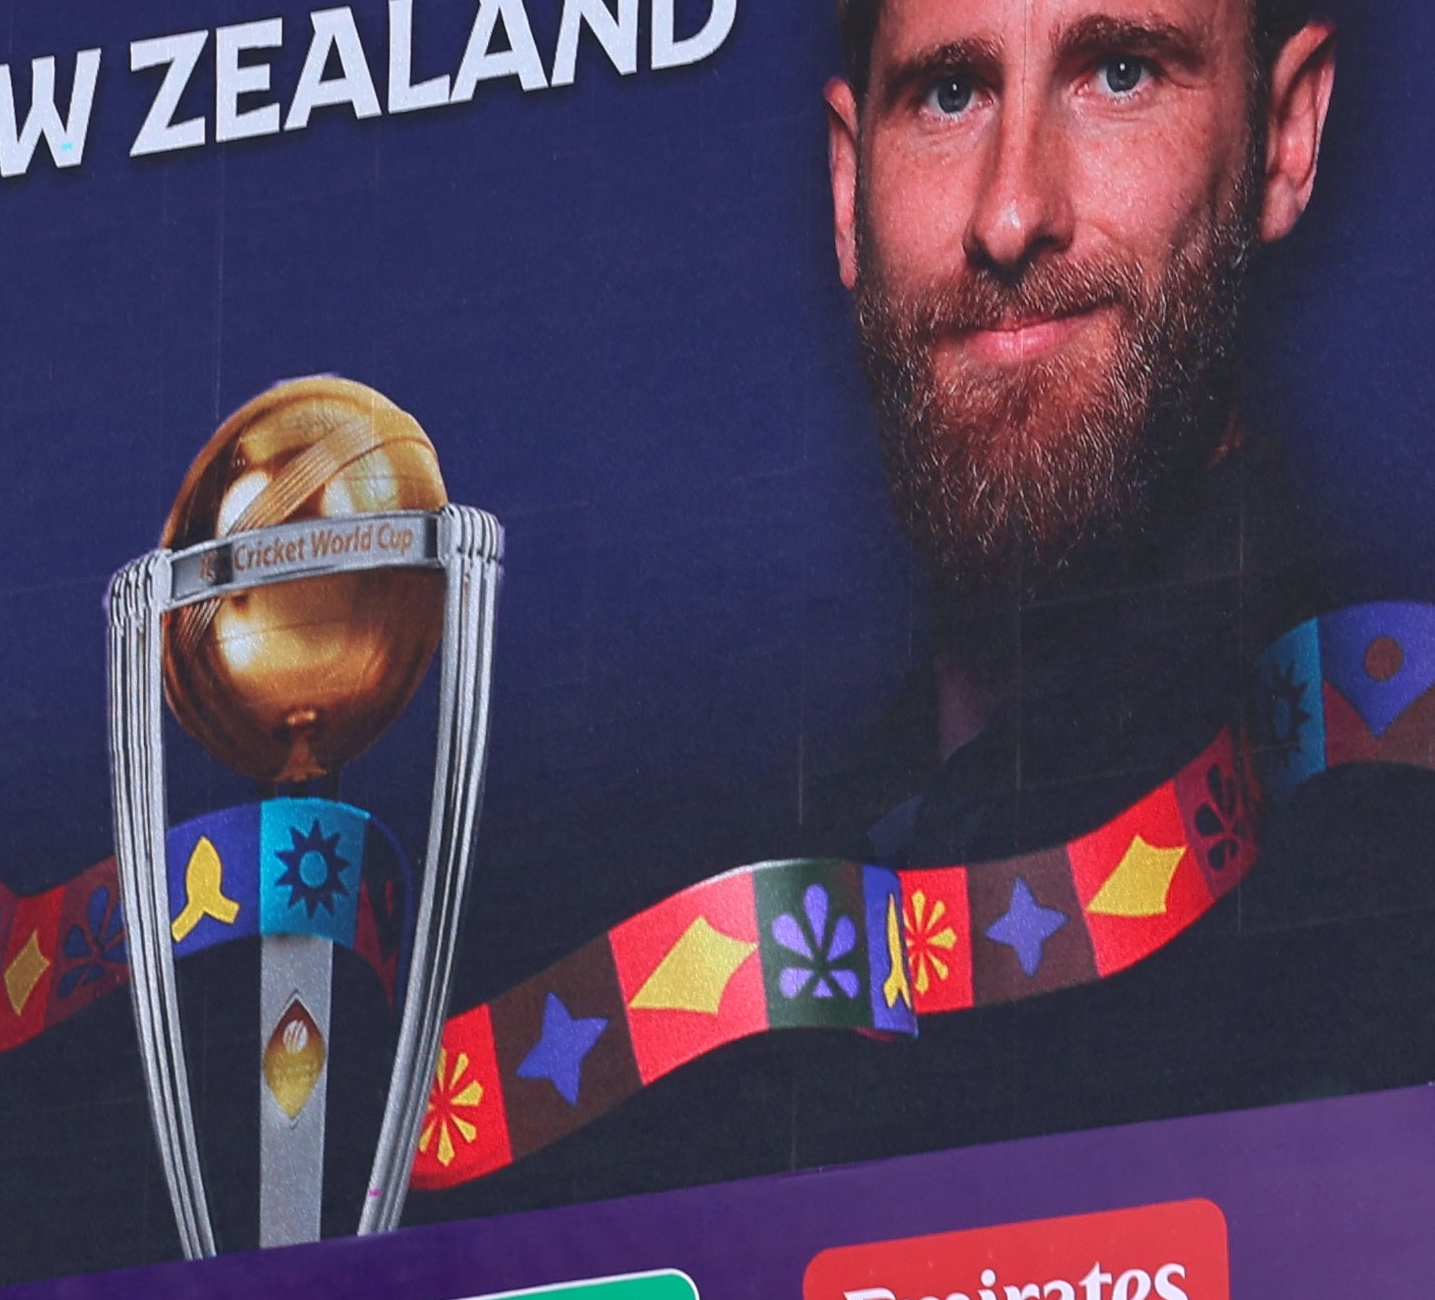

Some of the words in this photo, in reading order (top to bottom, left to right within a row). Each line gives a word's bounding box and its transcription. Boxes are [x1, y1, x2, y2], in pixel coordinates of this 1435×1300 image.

[234, 534, 306, 572] Cricket
[310, 523, 374, 559] World
[377, 521, 414, 555] Cup
